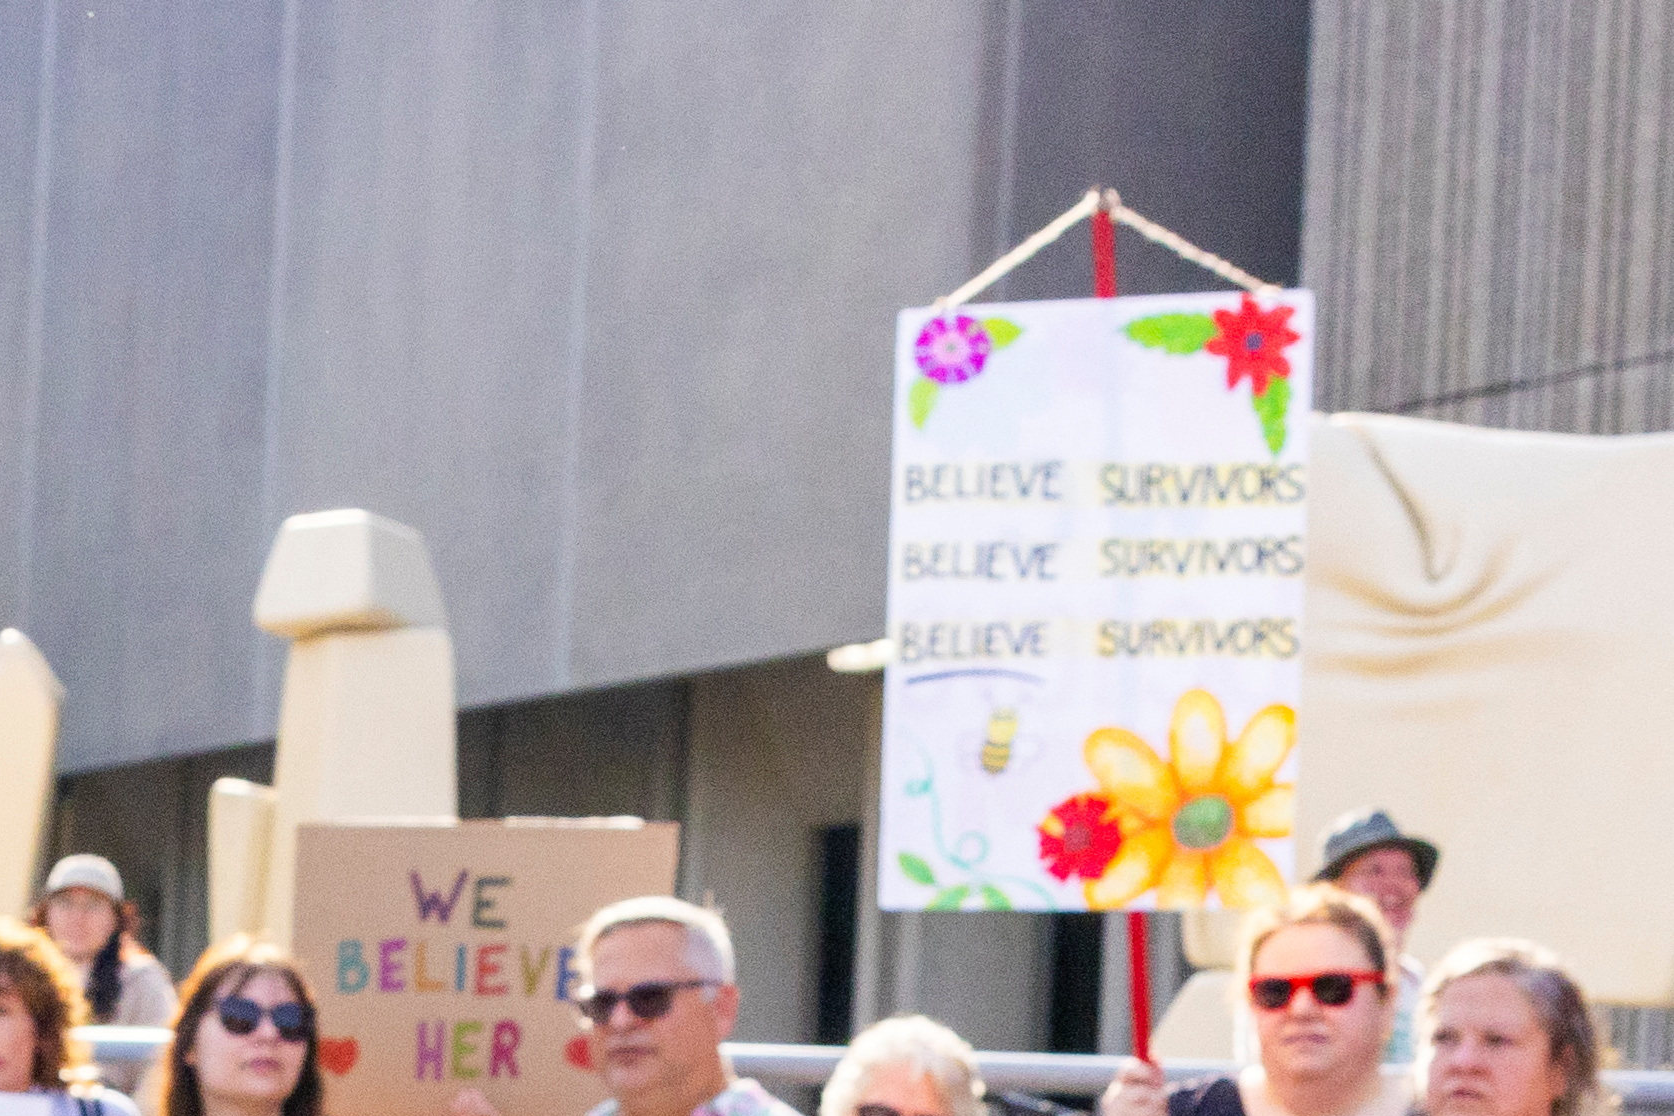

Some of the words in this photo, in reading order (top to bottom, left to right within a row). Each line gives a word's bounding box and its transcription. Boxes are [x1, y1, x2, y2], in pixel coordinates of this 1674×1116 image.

[904, 462, 1064, 504] BELIEVE
[1098, 462, 1306, 506] SURVIVORS
[901, 540, 1060, 581] BELIEVE
[1099, 533, 1304, 579] SURVIVORS
[898, 619, 1050, 664] BELIEVE
[1095, 616, 1301, 660] SURVIVORS
[408, 867, 514, 930] WE
[416, 1019, 522, 1082] HER
